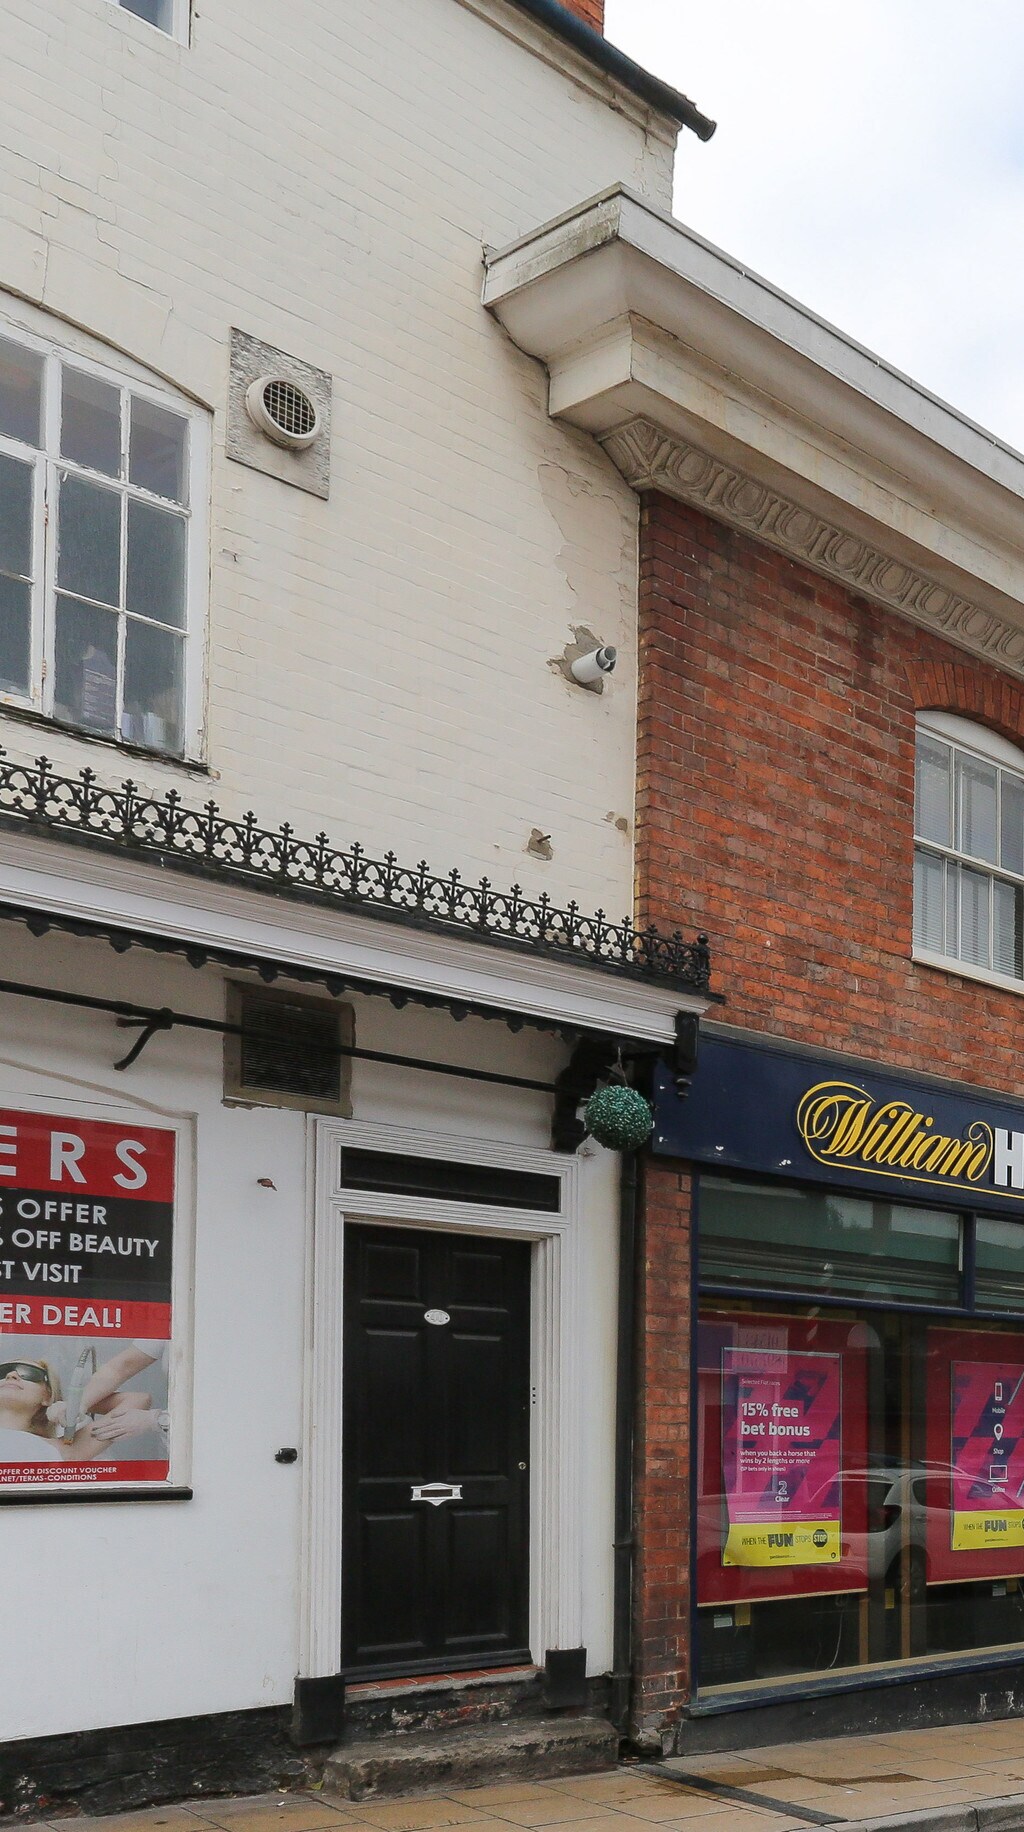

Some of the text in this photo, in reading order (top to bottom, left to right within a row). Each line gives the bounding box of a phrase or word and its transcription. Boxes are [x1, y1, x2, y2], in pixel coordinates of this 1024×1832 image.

[797, 1081, 993, 1181] William
[17, 1199, 107, 1225] OFFER
[12, 1228, 159, 1258] OFF BEAUTY
[23, 1261, 82, 1283] VISIT
[43, 1305, 122, 1328] DEAL!
[741, 1402, 799, 1417] 15% free
[741, 1421, 811, 1436] bet bonus
[778, 1480, 787, 1495] 2
[984, 1519, 1007, 1532] FUN
[741, 1533, 827, 1548] WHEN THE FUN STOPS STOP
